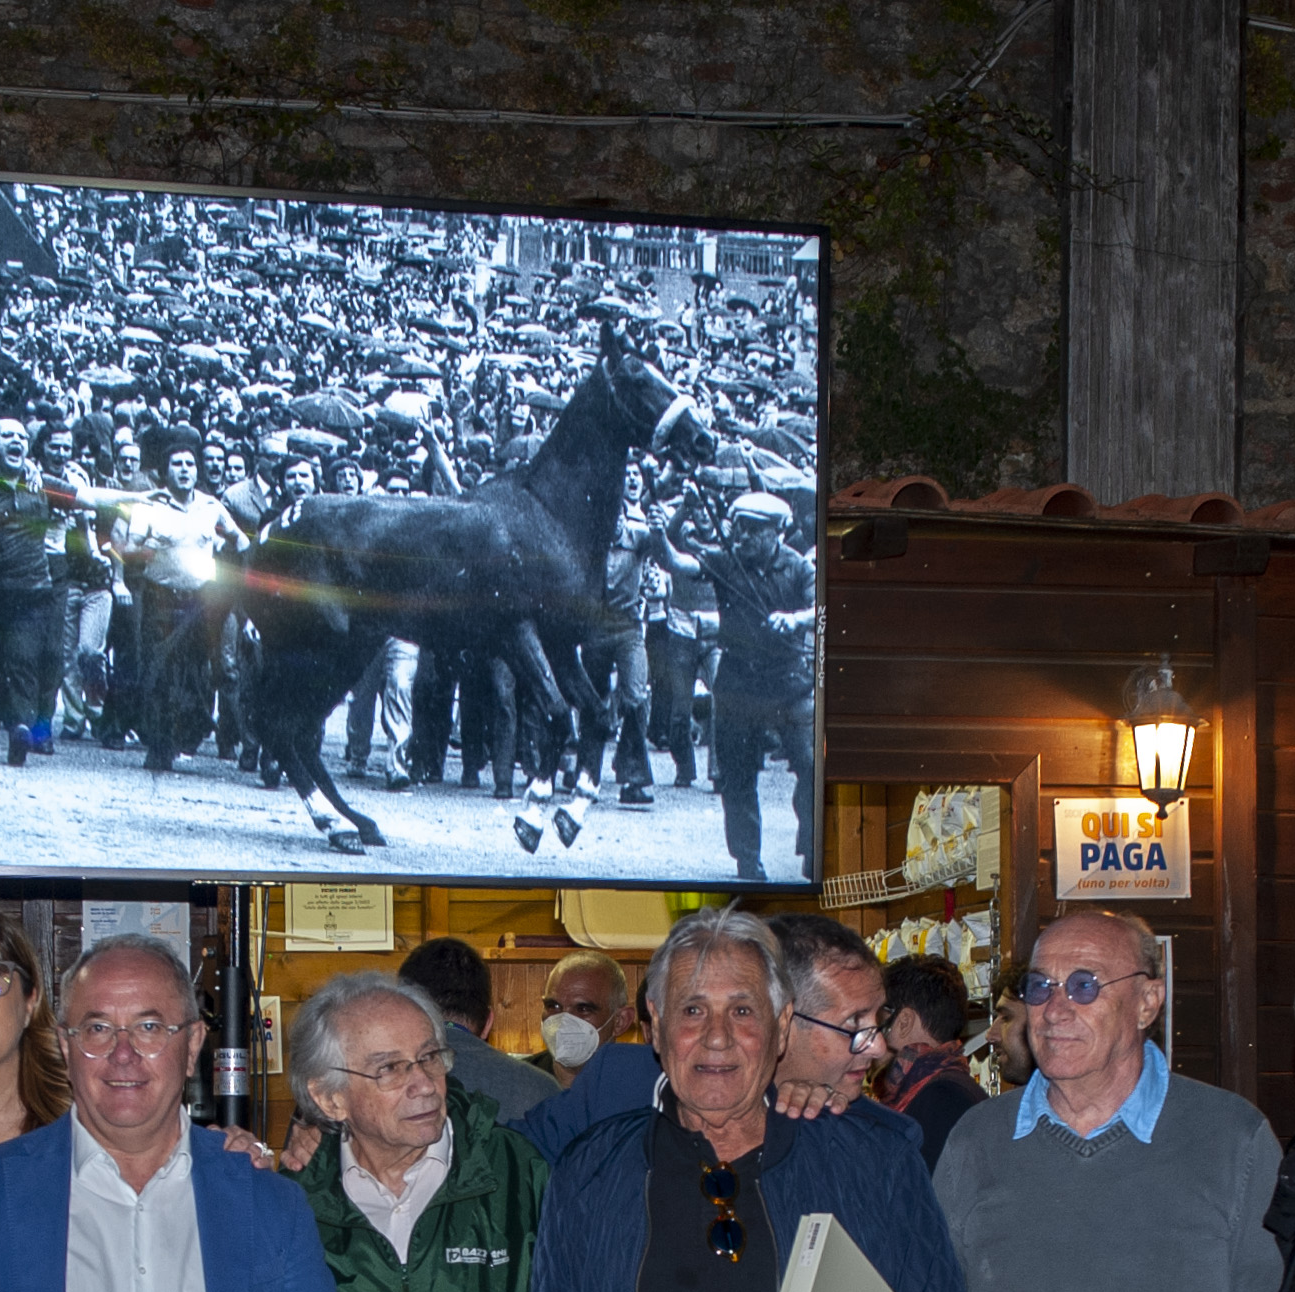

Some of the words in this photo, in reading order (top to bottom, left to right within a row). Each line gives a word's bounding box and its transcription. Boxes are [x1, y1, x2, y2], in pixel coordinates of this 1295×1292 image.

[1081, 812, 1130, 841] QUI
[1137, 812, 1164, 838] SI
[1080, 842, 1168, 870] PAGA
[1076, 878, 1106, 890] (uno
[1108, 879, 1130, 890] per
[1132, 878, 1170, 890] volta)
